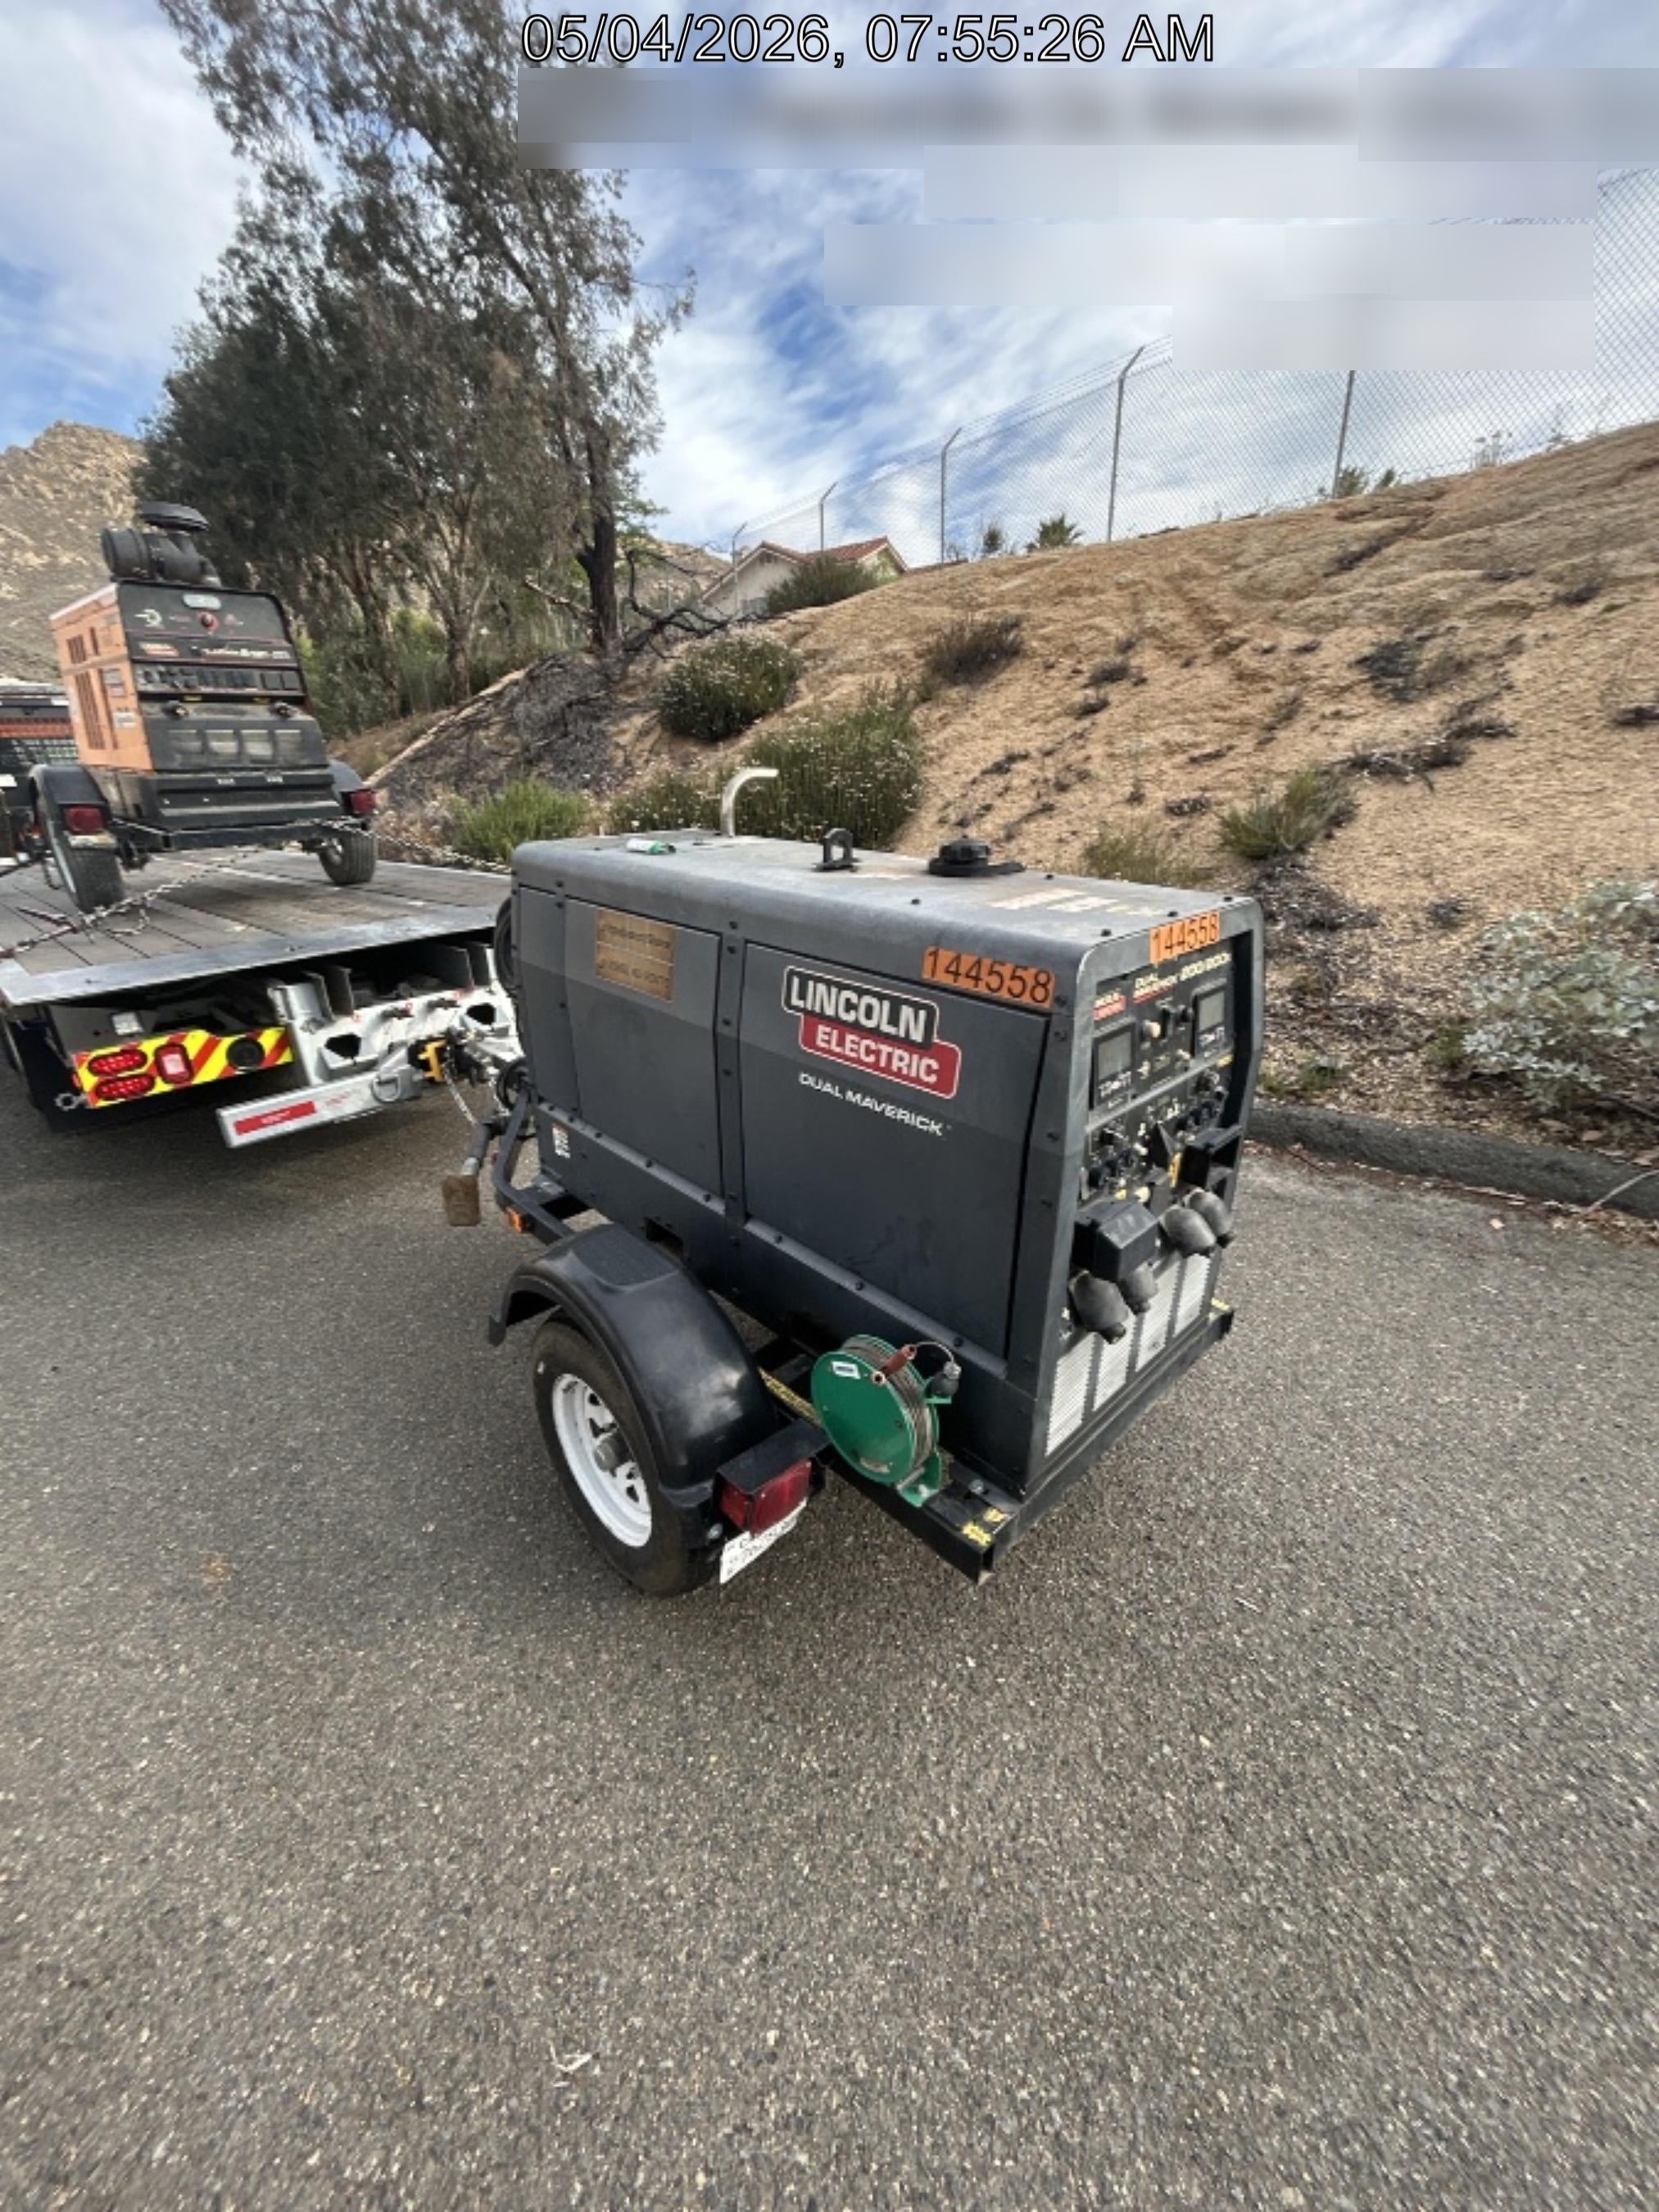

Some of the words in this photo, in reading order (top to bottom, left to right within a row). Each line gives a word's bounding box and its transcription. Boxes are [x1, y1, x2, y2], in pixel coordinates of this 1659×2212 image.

[1153, 913, 1218, 959] 144558
[926, 947, 1051, 1004] 144558
[789, 976, 927, 1043] LINCOLN
[815, 1024, 941, 1085] ELECTRIC
[799, 1072, 843, 1100] DUAL
[845, 1090, 944, 1136] MAVERICK
